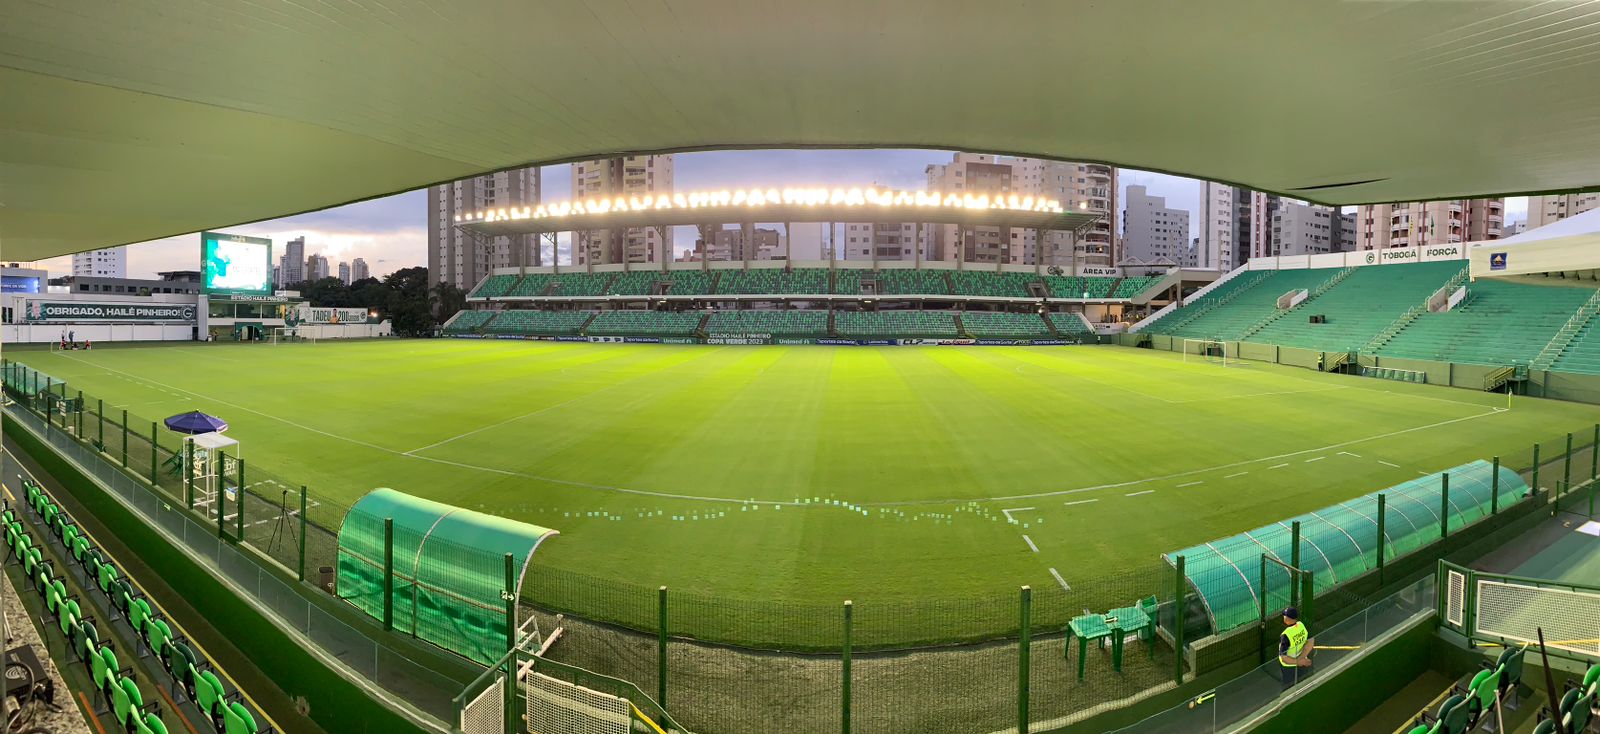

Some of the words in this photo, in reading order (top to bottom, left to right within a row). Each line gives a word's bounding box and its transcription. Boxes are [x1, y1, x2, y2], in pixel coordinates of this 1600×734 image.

[1083, 267, 1103, 275] ÁREA
[46, 306, 105, 317] OBRIGADO,
[106, 306, 136, 317] HAILÉ
[136, 308, 181, 317] PINHEIRO!
[312, 310, 332, 322] TADEU
